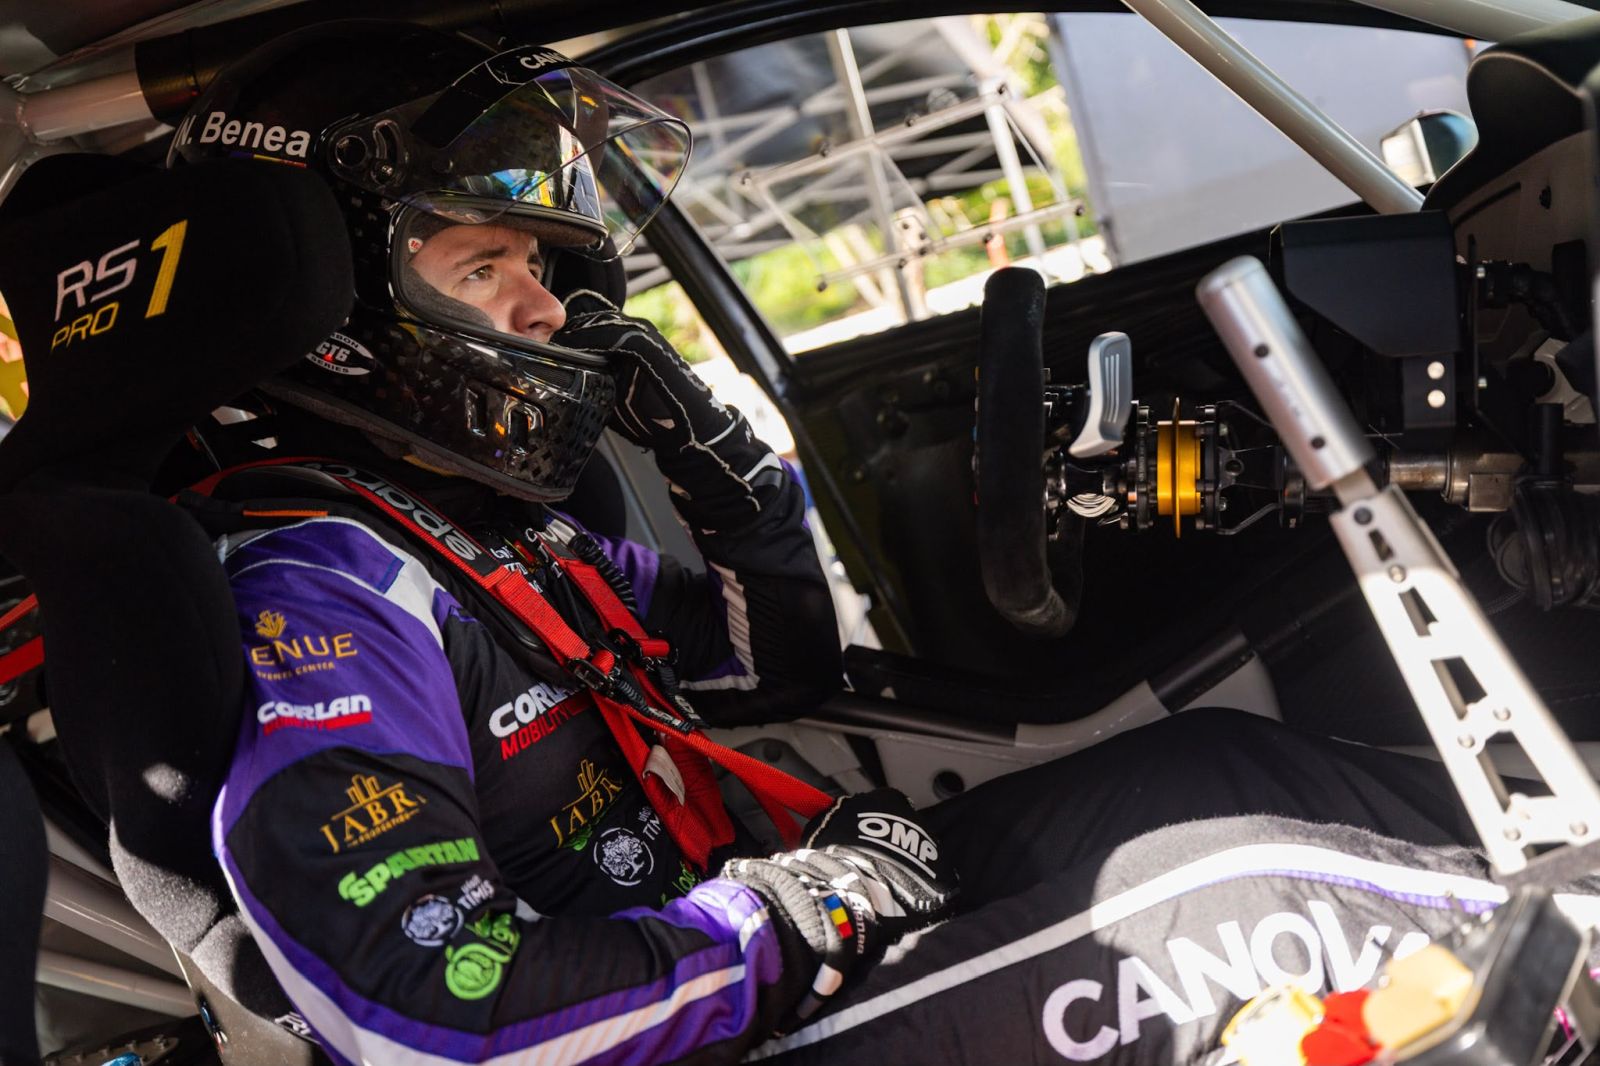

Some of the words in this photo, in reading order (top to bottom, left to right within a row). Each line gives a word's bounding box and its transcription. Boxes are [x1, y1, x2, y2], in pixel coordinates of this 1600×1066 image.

[200, 111, 311, 158] Benea
[55, 239, 141, 322] RS
[145, 219, 188, 319] 1
[51, 302, 119, 351] PRO
[310, 356, 350, 374] SERIES
[318, 463, 483, 561] sparc
[251, 632, 358, 666] ENUE
[257, 694, 372, 724] CORLAN
[489, 682, 576, 738] CORL
[501, 702, 571, 761] MOBILITY
[320, 788, 418, 853] JABR
[551, 777, 623, 849] JABR
[857, 817, 939, 863] OMP
[338, 838, 480, 907] SPARTAN
[1042, 900, 1429, 1061] CANOV
